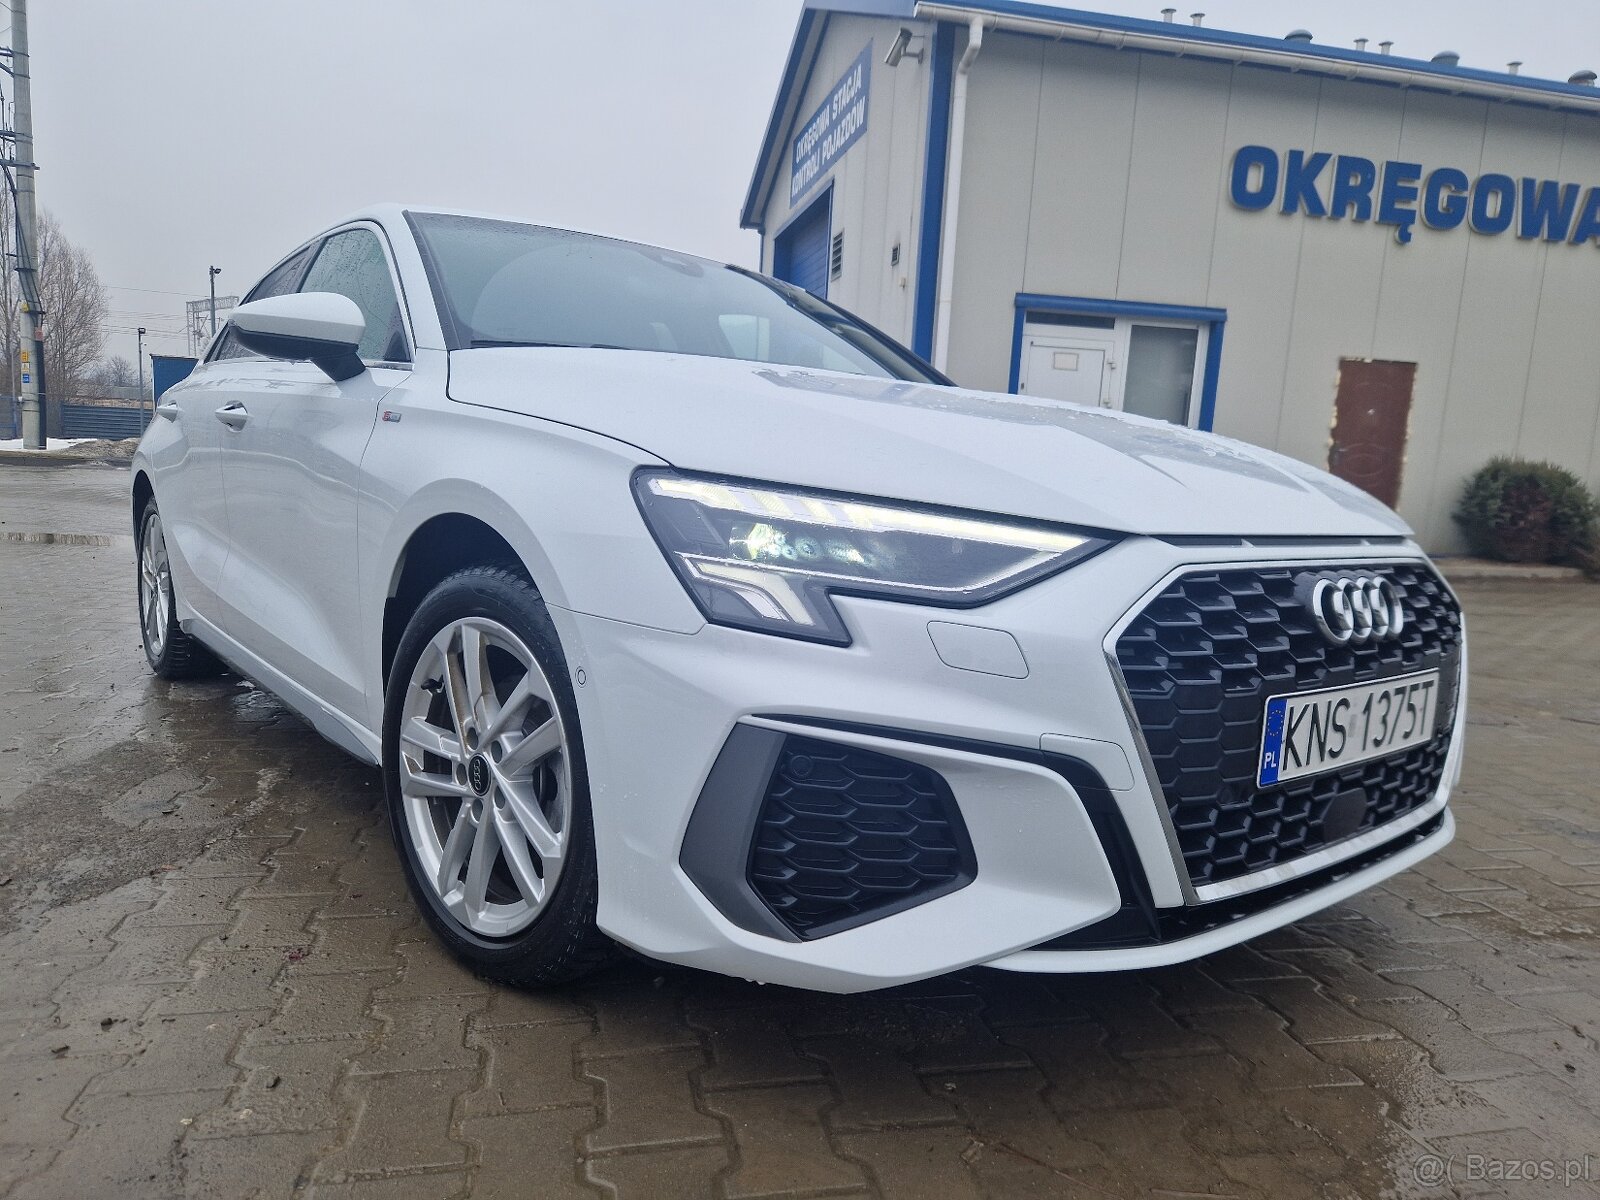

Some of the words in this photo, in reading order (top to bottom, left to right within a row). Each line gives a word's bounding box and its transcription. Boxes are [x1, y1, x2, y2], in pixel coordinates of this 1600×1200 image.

[832, 63, 862, 121] STACJA
[821, 96, 866, 166] POJAZDÓW
[1282, 698, 1350, 771] KNS
[1362, 680, 1434, 752] 1375T
[1264, 752, 1277, 770] PL
